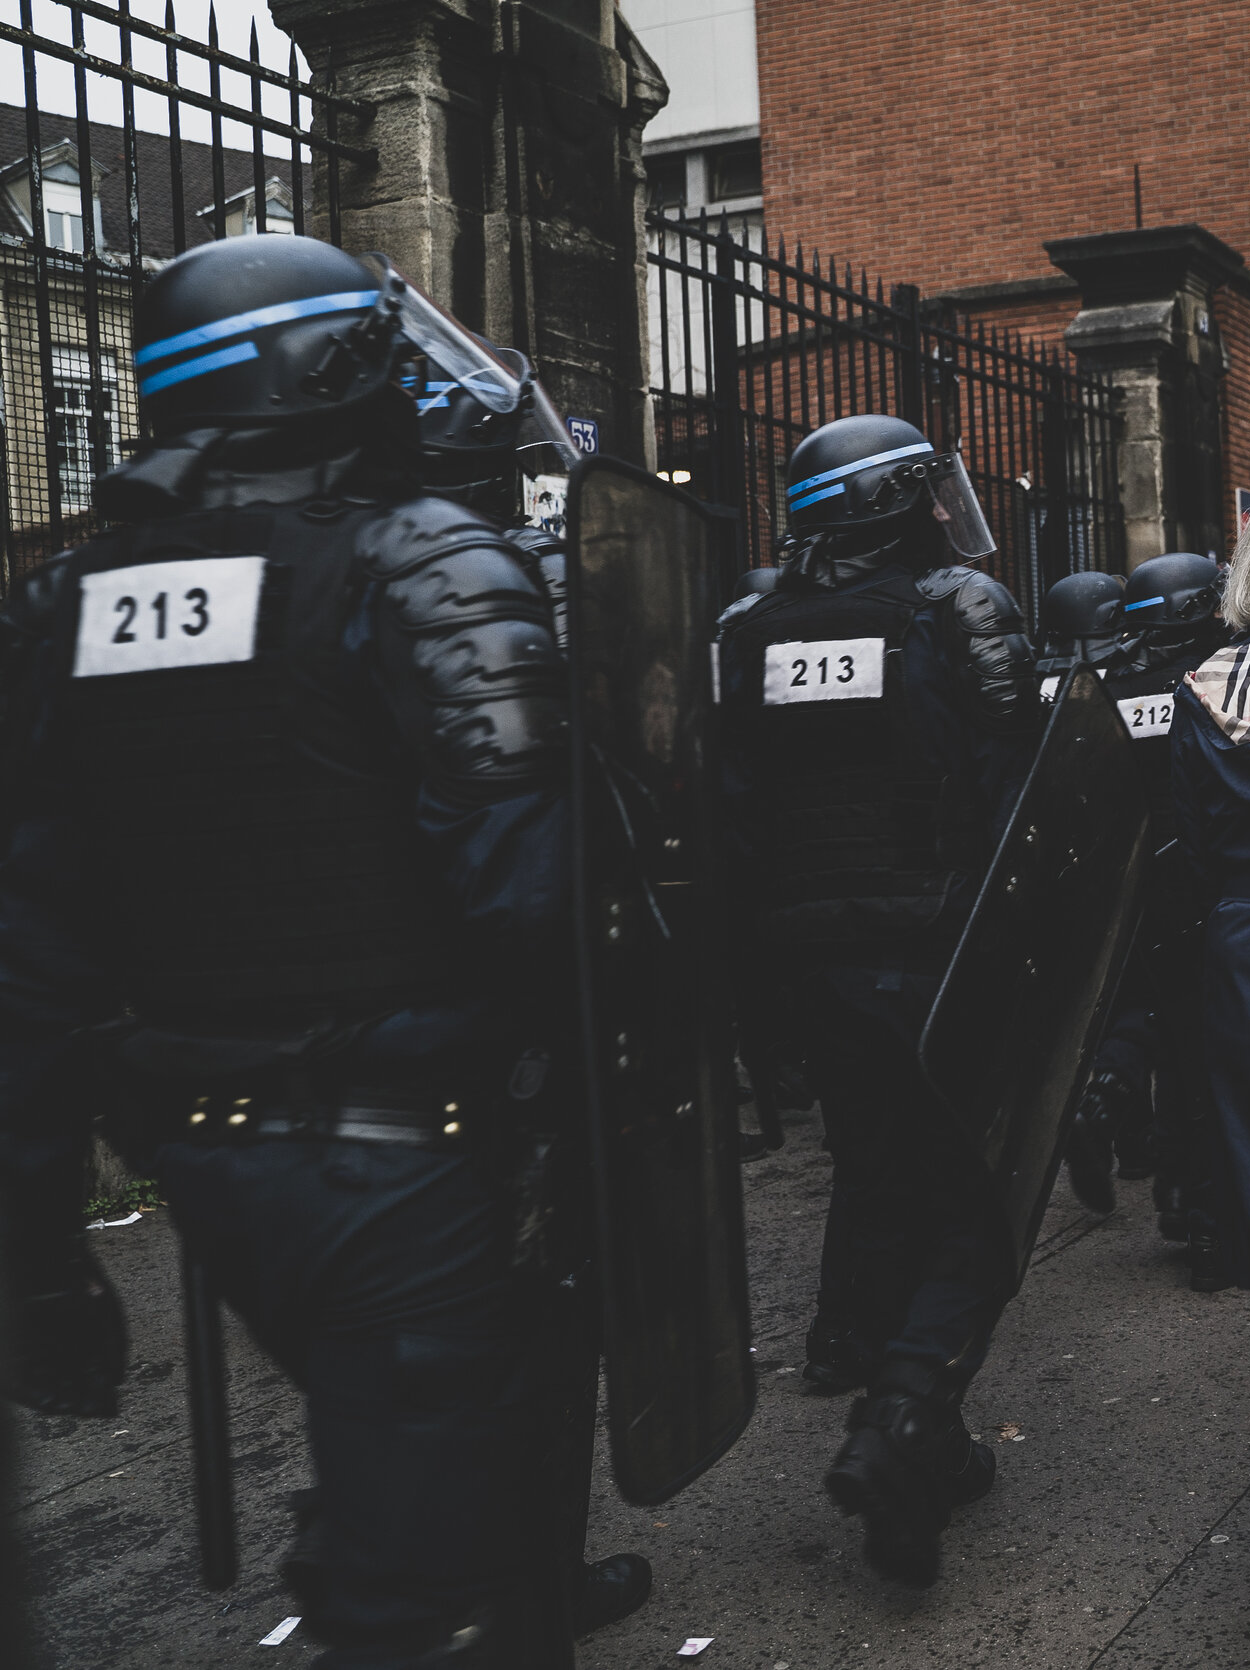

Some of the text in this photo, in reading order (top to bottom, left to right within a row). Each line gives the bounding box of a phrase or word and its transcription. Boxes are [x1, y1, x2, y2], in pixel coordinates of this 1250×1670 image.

[571, 421, 596, 453] 53
[112, 587, 209, 644] 213
[790, 655, 855, 687] 213
[1132, 705, 1171, 727] 212
